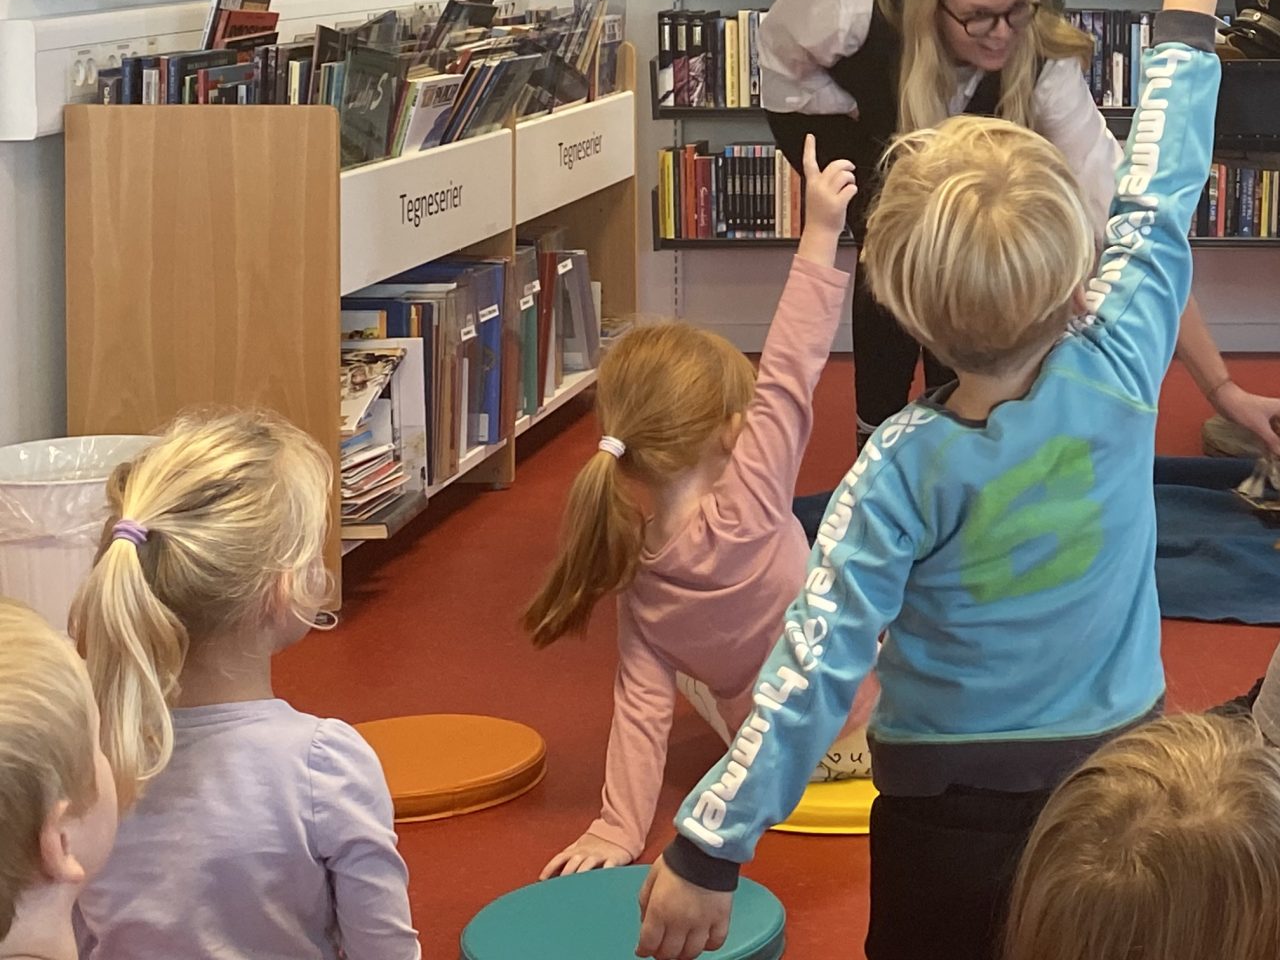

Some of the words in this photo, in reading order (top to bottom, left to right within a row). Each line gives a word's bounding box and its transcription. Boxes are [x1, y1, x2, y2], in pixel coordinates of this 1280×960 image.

[558, 131, 603, 170] Tegneserier
[1118, 48, 1192, 208] hummel
[400, 180, 463, 227] Tegneserier
[683, 665, 809, 849] hummel
